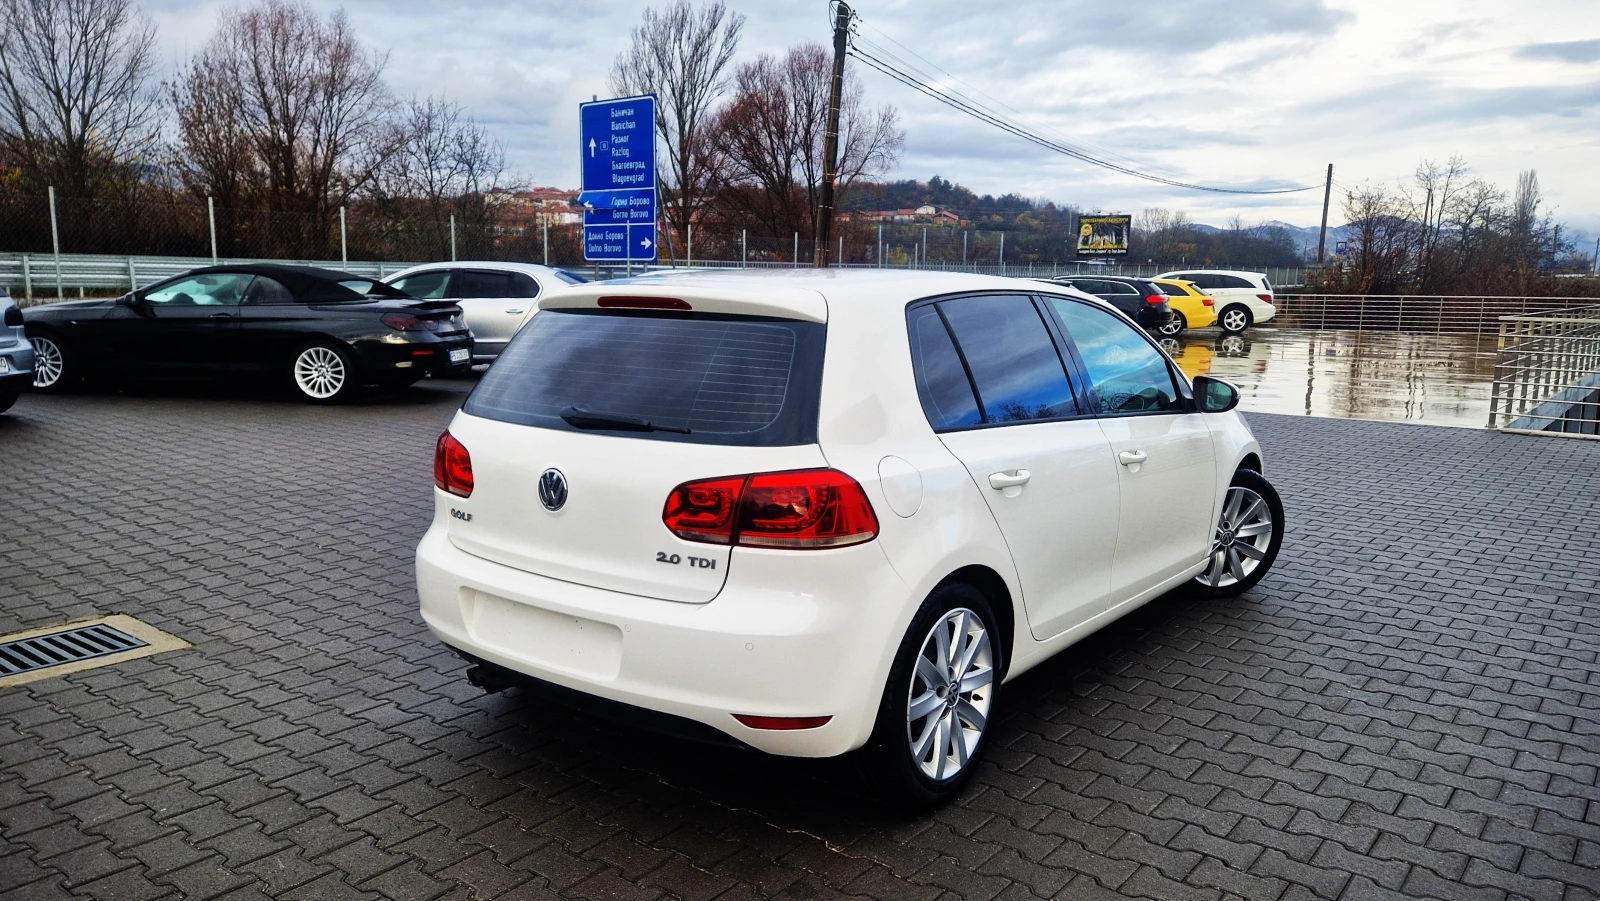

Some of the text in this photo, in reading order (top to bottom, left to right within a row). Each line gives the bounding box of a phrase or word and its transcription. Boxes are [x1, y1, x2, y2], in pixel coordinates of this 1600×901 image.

[611, 120, 636, 131] Banichan
[612, 134, 629, 144] Разлог
[612, 147, 630, 158] Razlog
[612, 160, 646, 171] Благоевград
[612, 172, 645, 185] Blagoevgrad
[629, 196, 650, 207] Борово
[613, 209, 649, 219] Gorno Borovo
[588, 243, 622, 253] Dolno Borovo
[450, 507, 473, 522] GOLF
[687, 556, 717, 570] TDI
